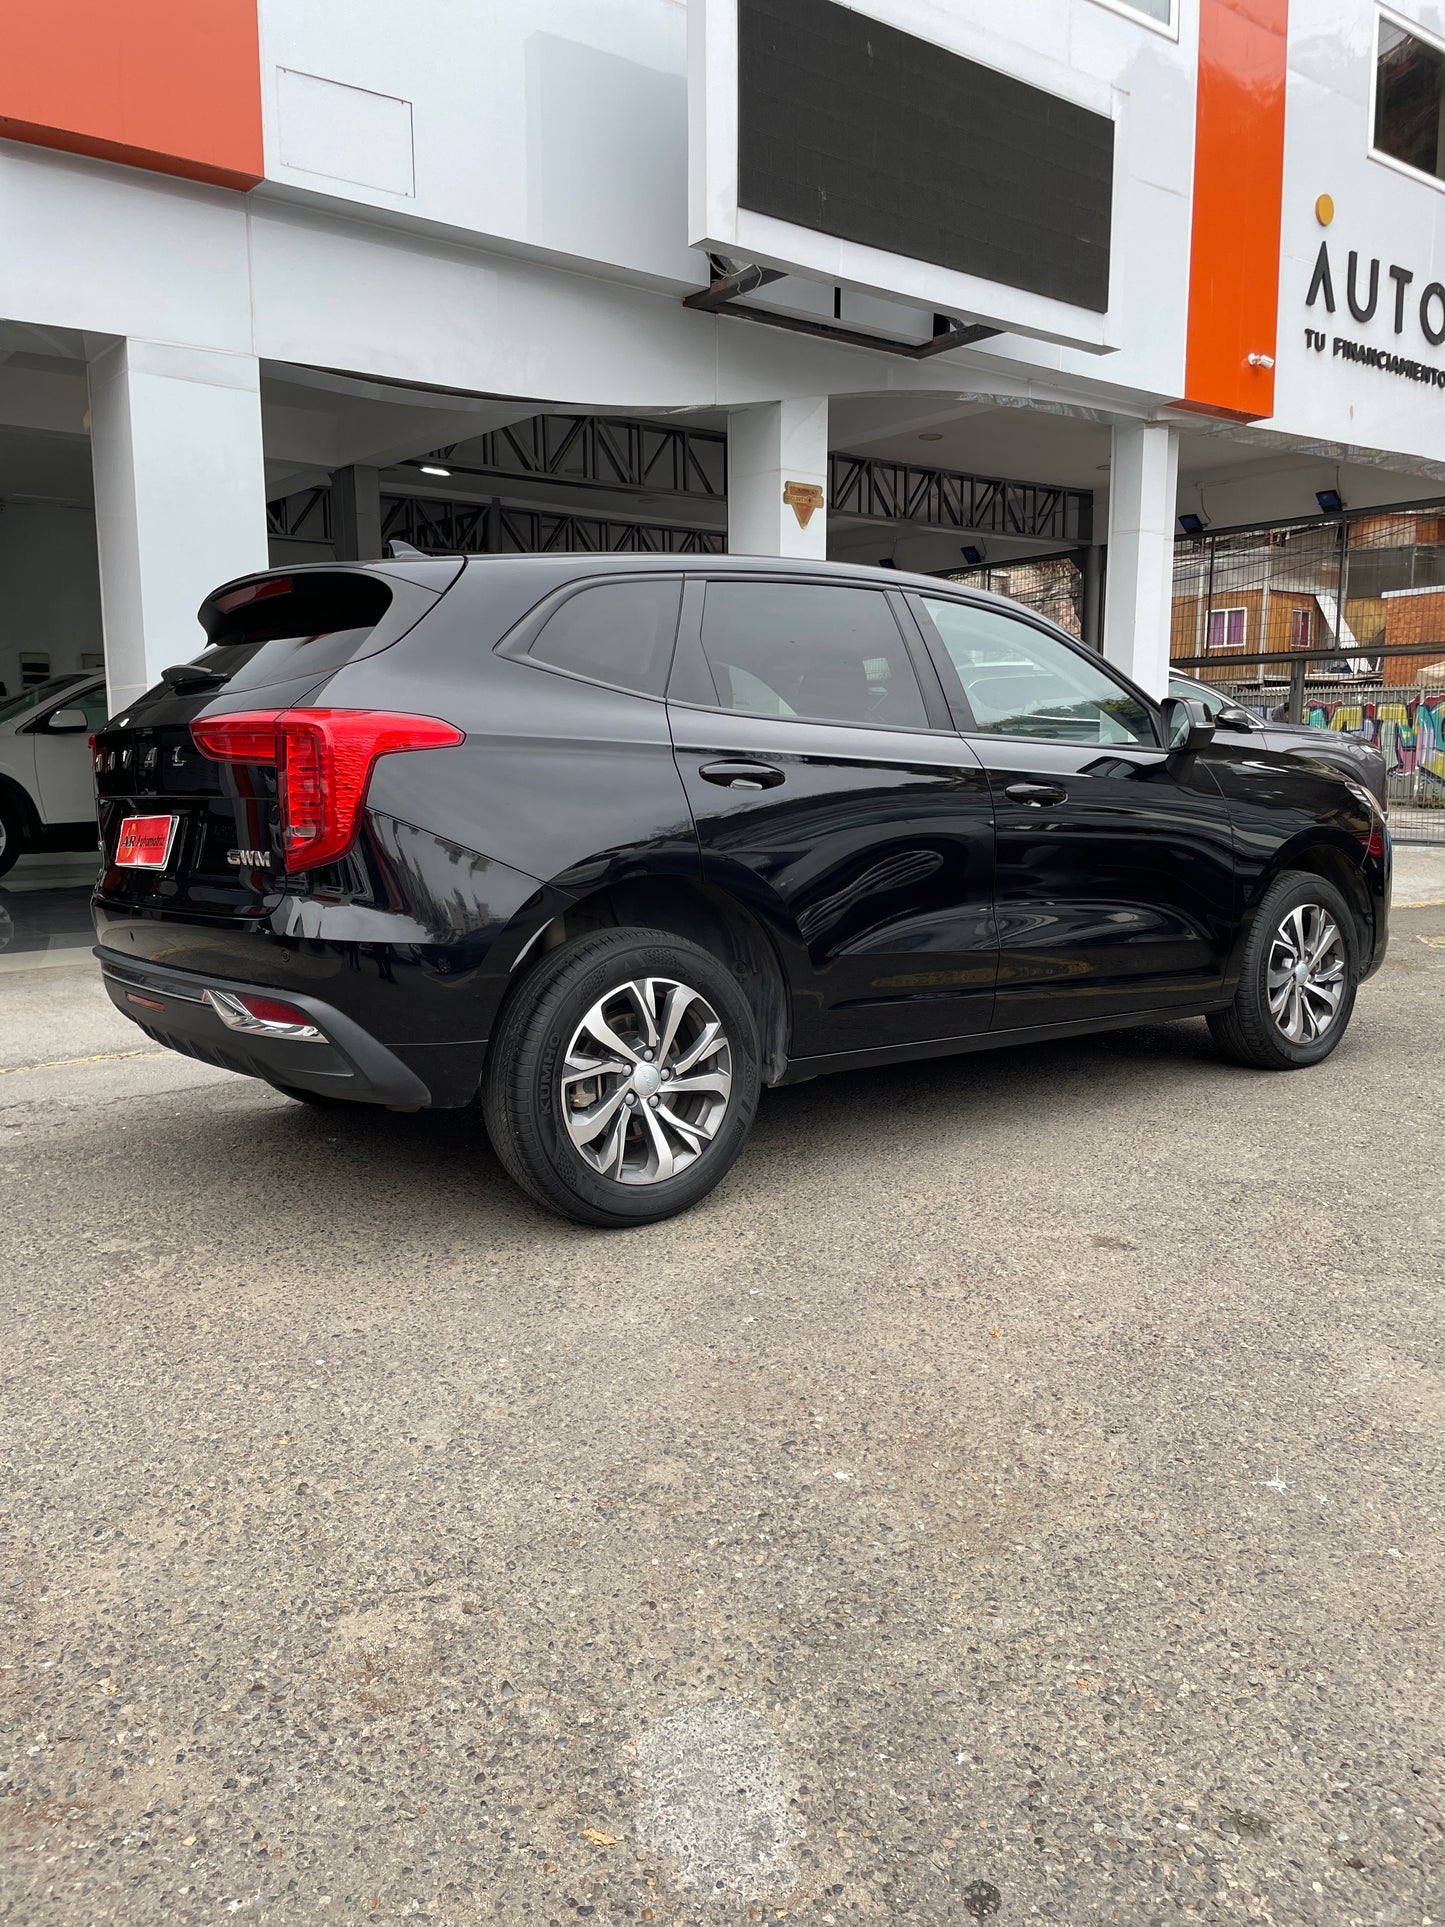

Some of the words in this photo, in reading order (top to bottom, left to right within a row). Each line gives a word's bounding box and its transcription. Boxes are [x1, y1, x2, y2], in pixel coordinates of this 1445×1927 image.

[1305, 240, 1445, 346] AUTO
[1304, 328, 1326, 352] TU
[1333, 337, 1445, 389] FINANCIAMIENTO
[226, 848, 272, 868] GWM
[540, 1032, 560, 1116] KUMHO
